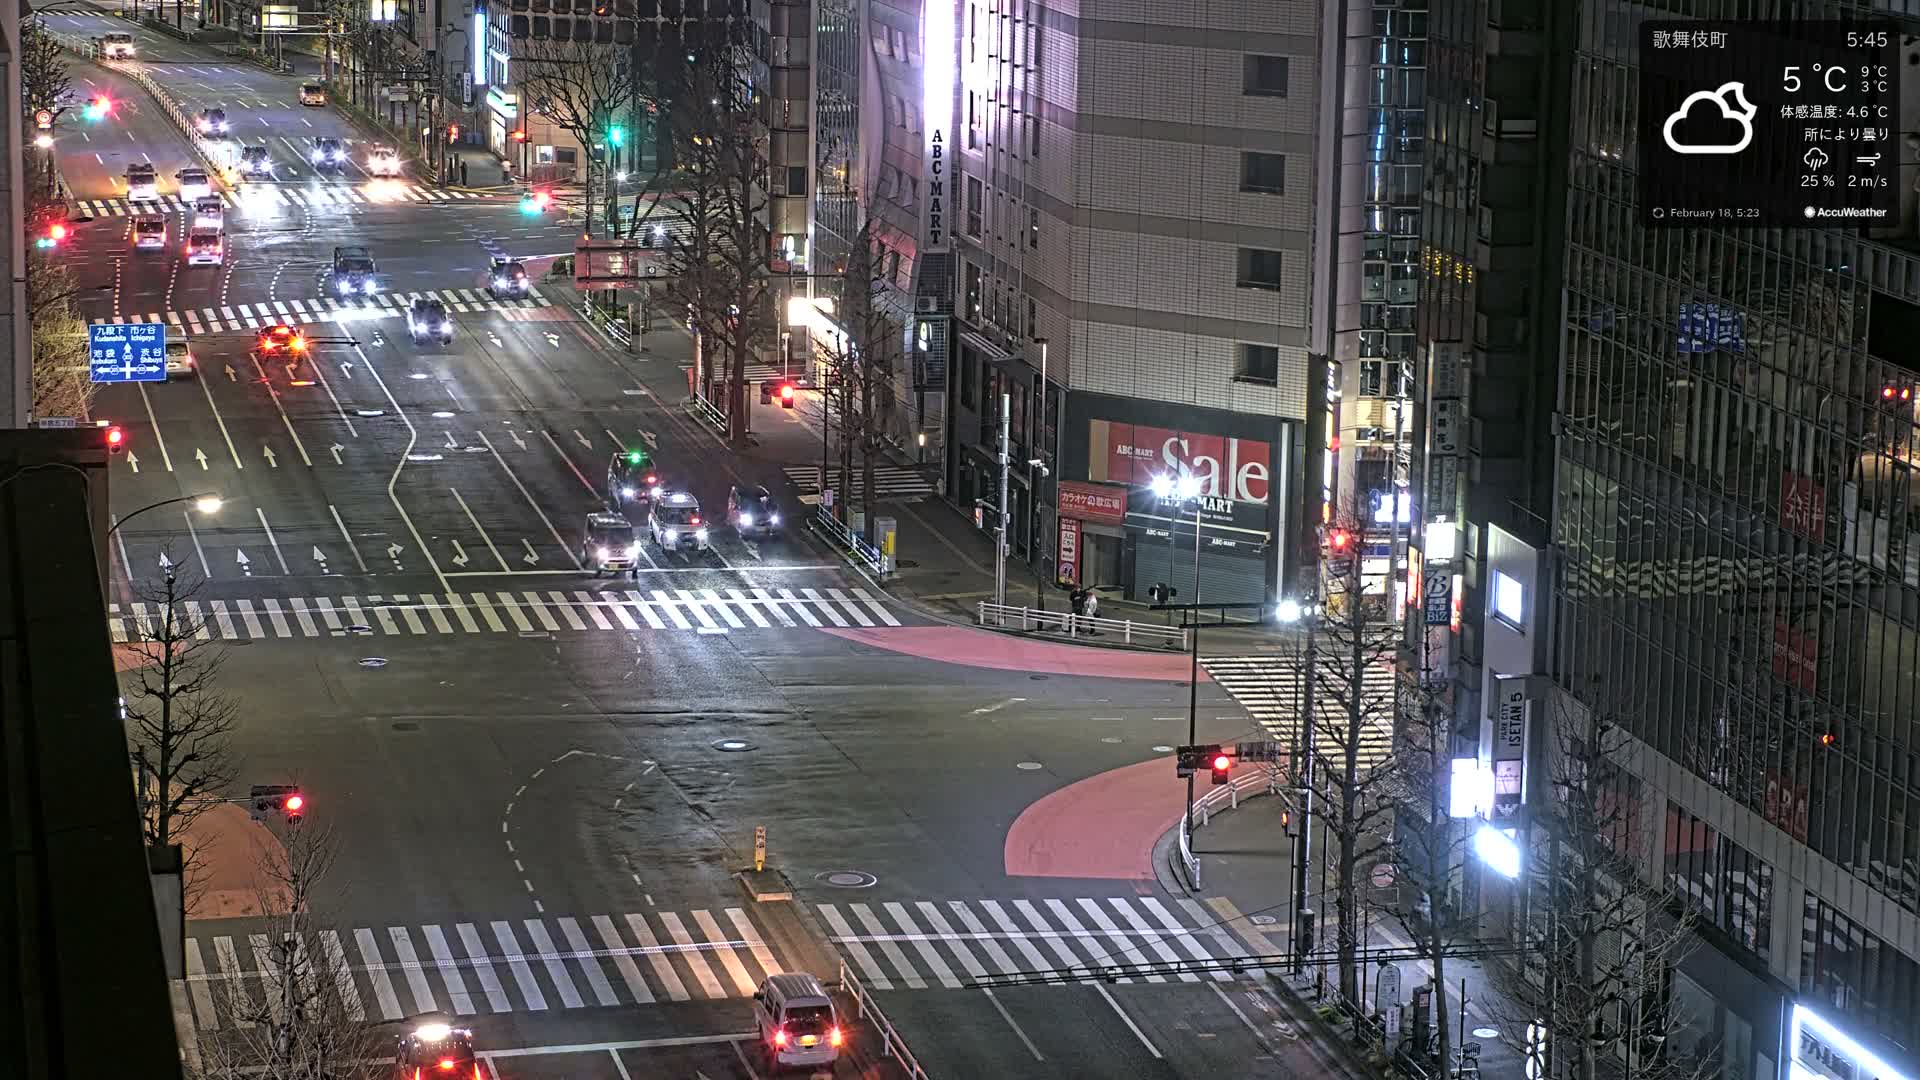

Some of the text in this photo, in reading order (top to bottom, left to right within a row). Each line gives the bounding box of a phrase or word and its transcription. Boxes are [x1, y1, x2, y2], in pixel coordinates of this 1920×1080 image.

[97, 326, 125, 335] 九段下
[1162, 436, 1269, 502] Sale
[1061, 491, 1088, 505] カラオケ
[1509, 692, 1523, 747] ISETAN 5
